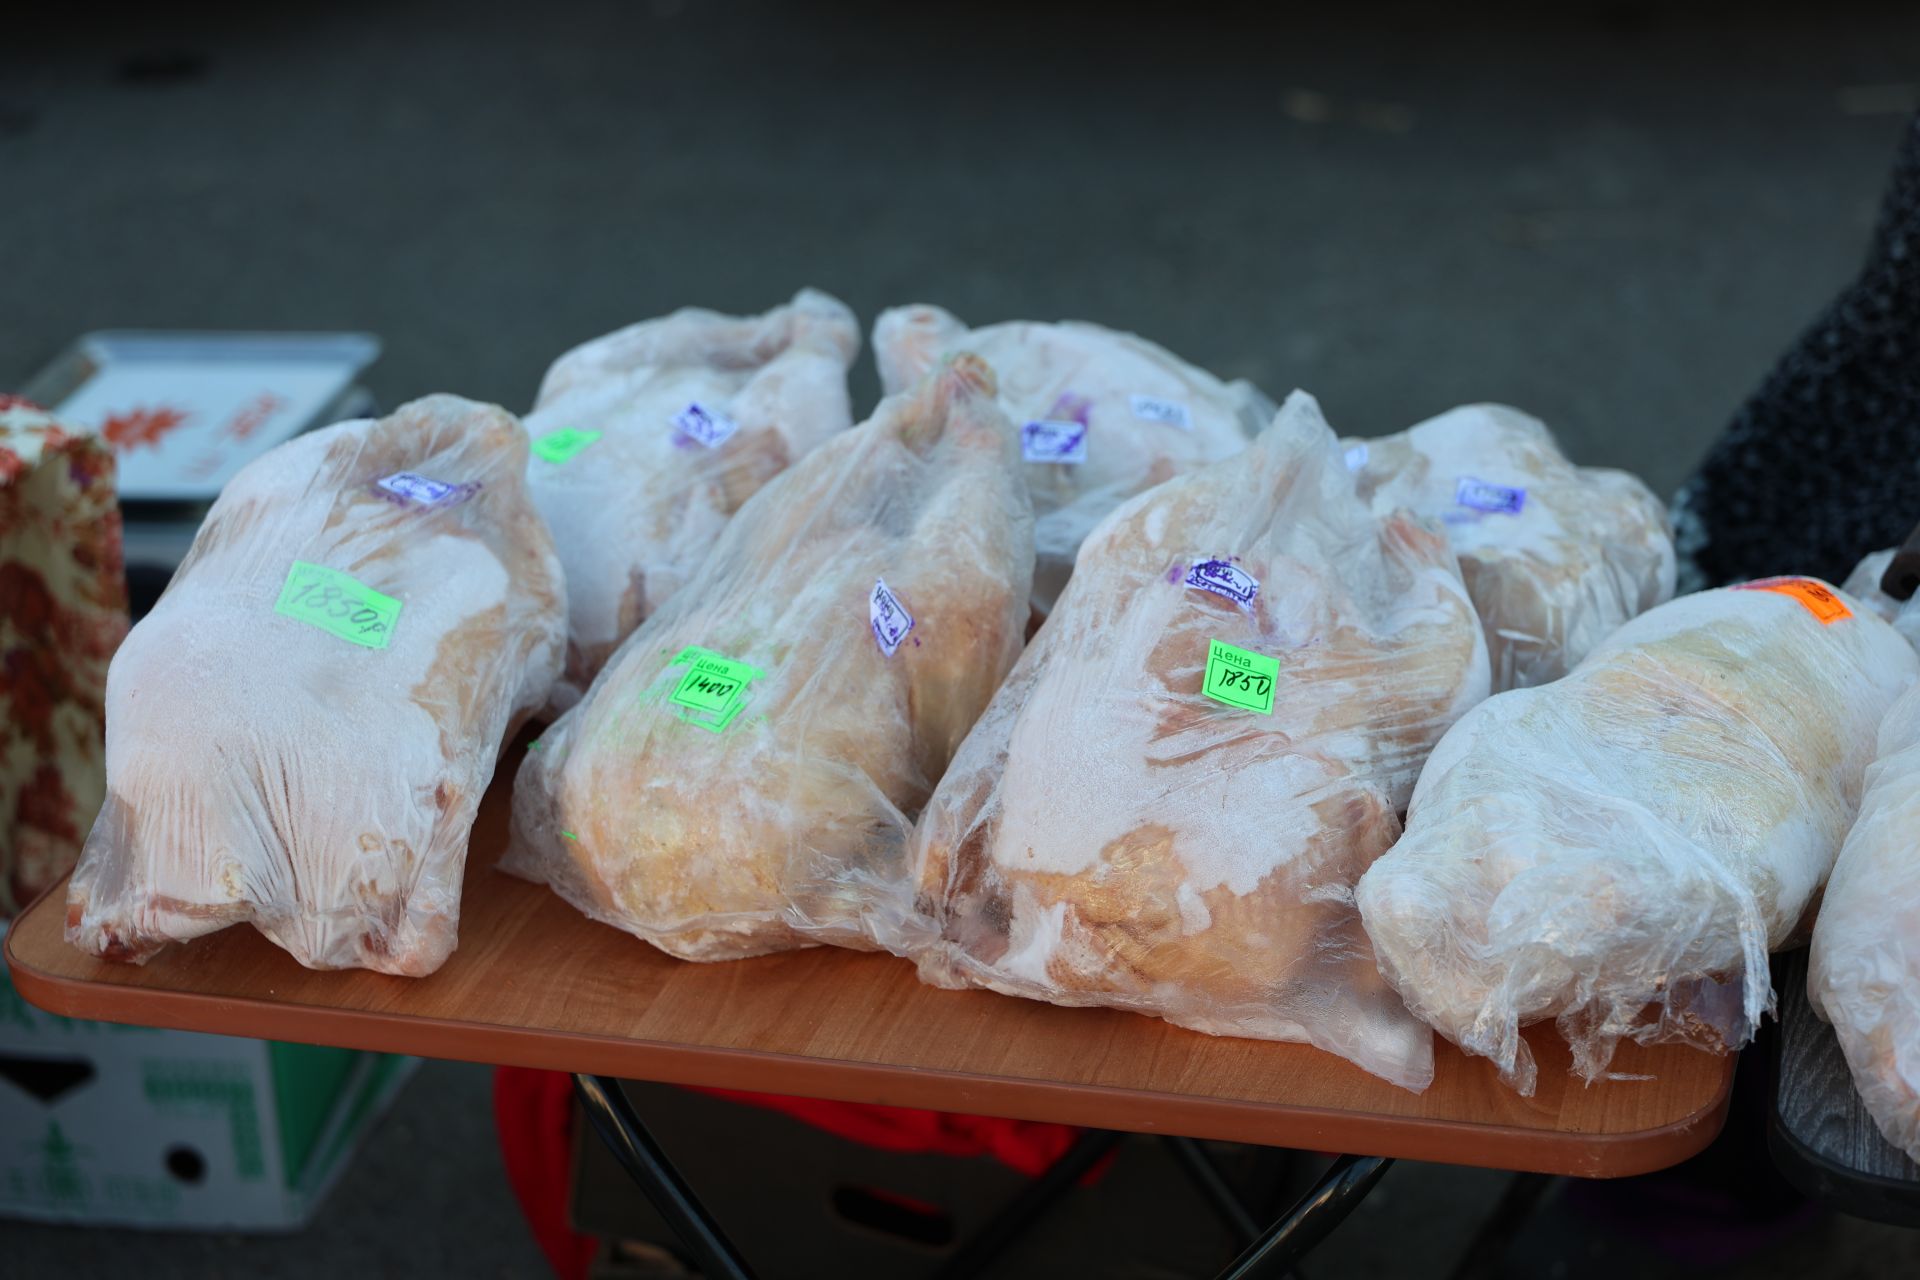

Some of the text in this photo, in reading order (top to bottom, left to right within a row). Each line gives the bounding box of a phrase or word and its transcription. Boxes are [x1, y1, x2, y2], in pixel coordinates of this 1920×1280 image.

[696, 658, 729, 675] Цена
[1213, 645, 1252, 668] Цена
[685, 675, 734, 697] 1400
[1219, 668, 1272, 696] 1850
